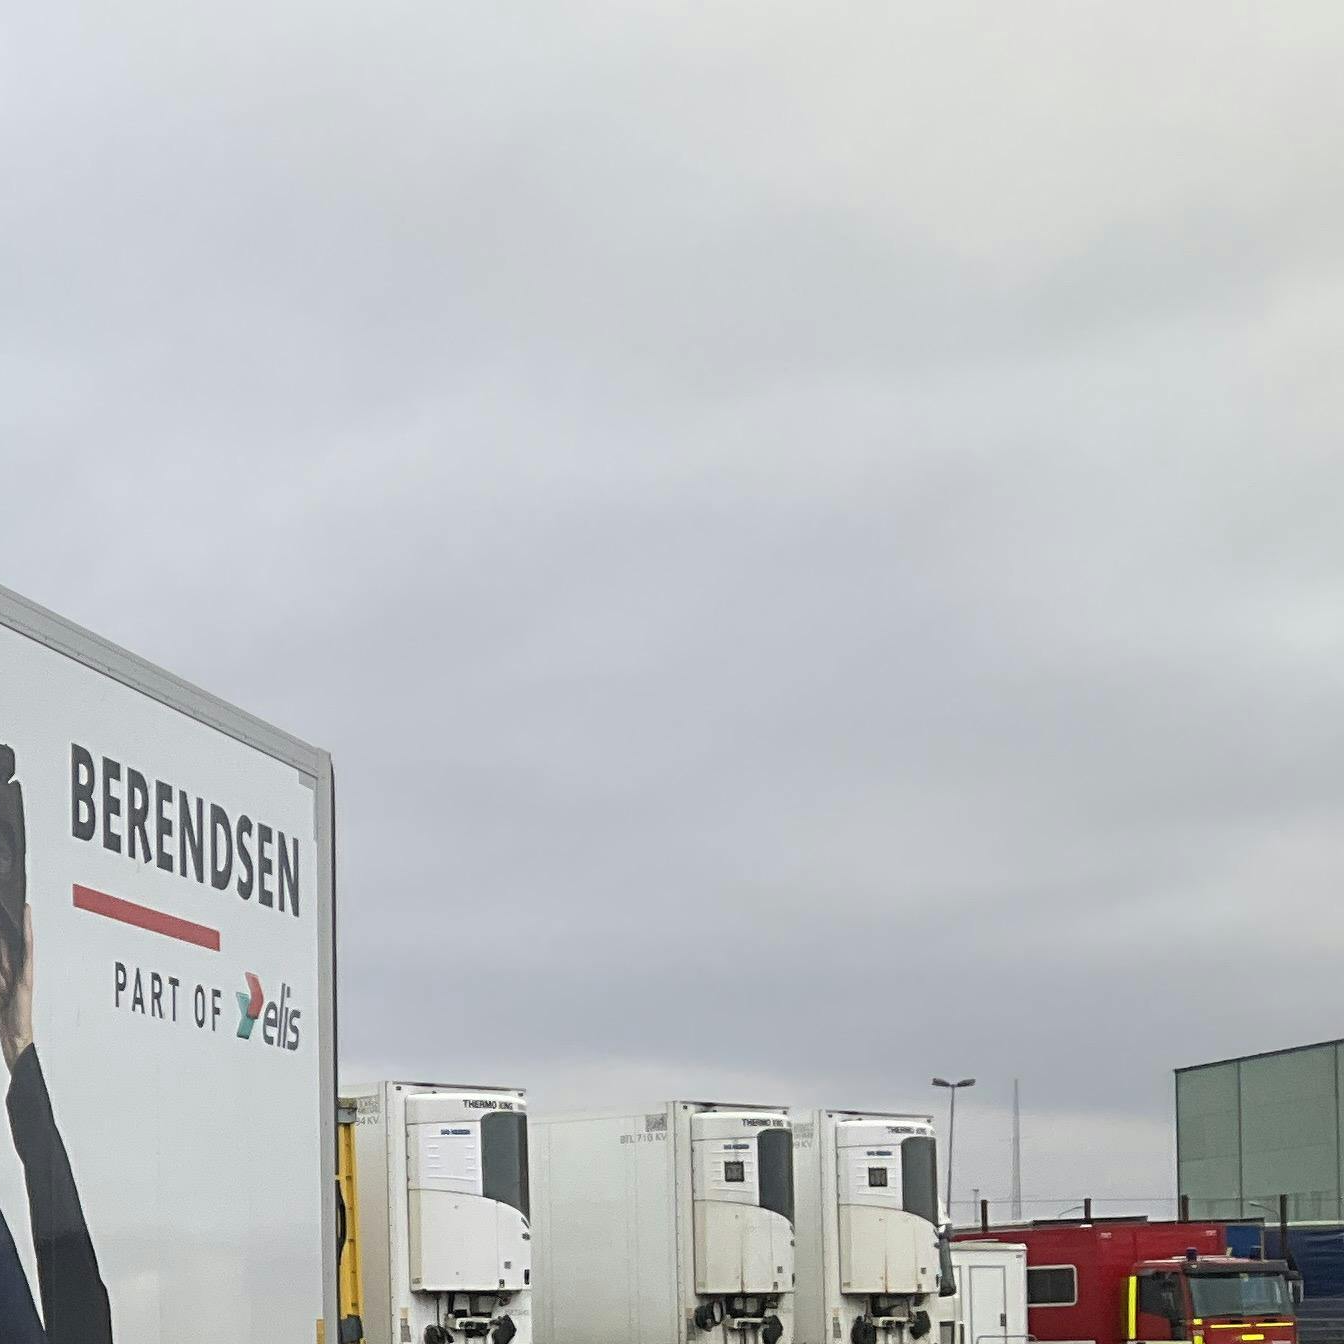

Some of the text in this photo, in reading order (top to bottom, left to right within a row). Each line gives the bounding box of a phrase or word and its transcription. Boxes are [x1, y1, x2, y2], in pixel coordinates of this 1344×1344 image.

[71, 742, 300, 918] BERENDSEN
[115, 961, 301, 1051] PART OF elis
[463, 1100, 497, 1110] THERMO
